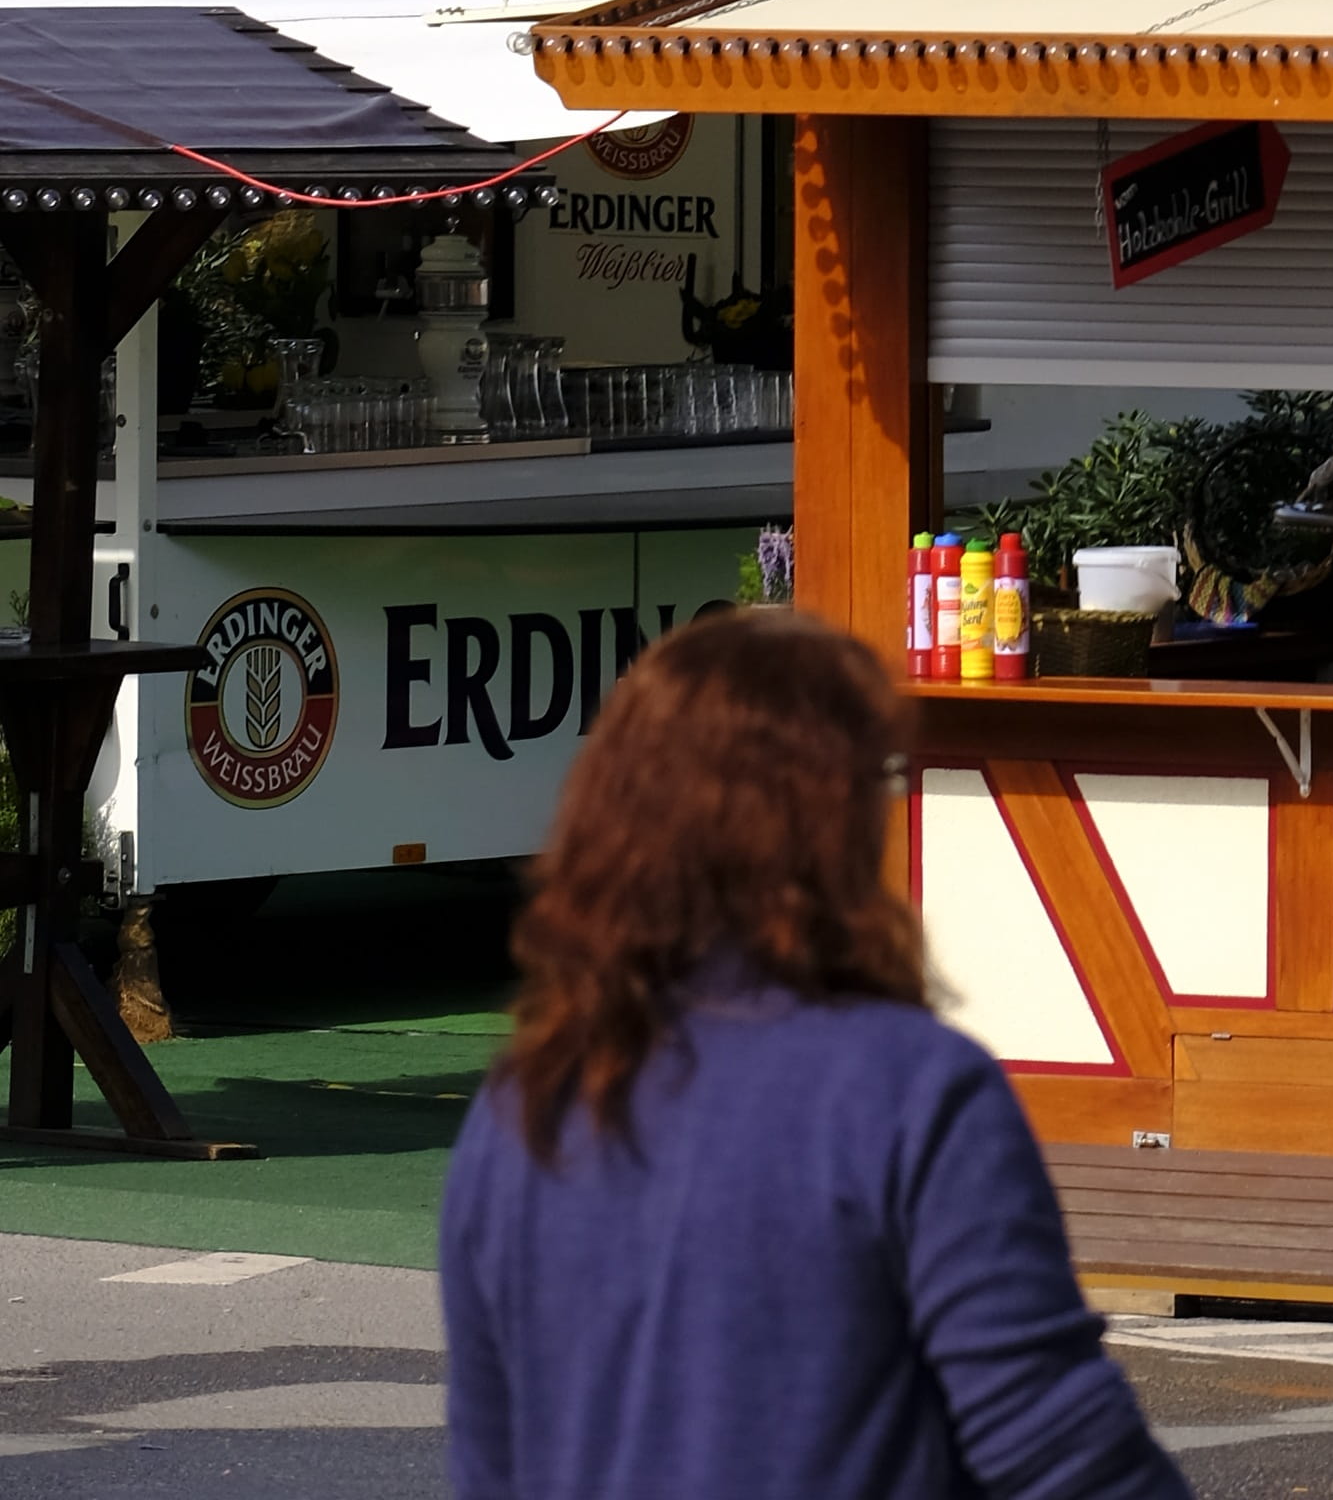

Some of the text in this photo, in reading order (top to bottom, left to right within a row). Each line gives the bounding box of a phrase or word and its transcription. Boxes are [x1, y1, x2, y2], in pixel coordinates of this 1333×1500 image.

[548, 188, 721, 239] ERDINGER
[1118, 165, 1250, 264] Holzkohle-Grill
[576, 243, 687, 291] Weißbier
[195, 601, 328, 687] ERDINGER
[201, 722, 323, 794] WEISSBRÄU
